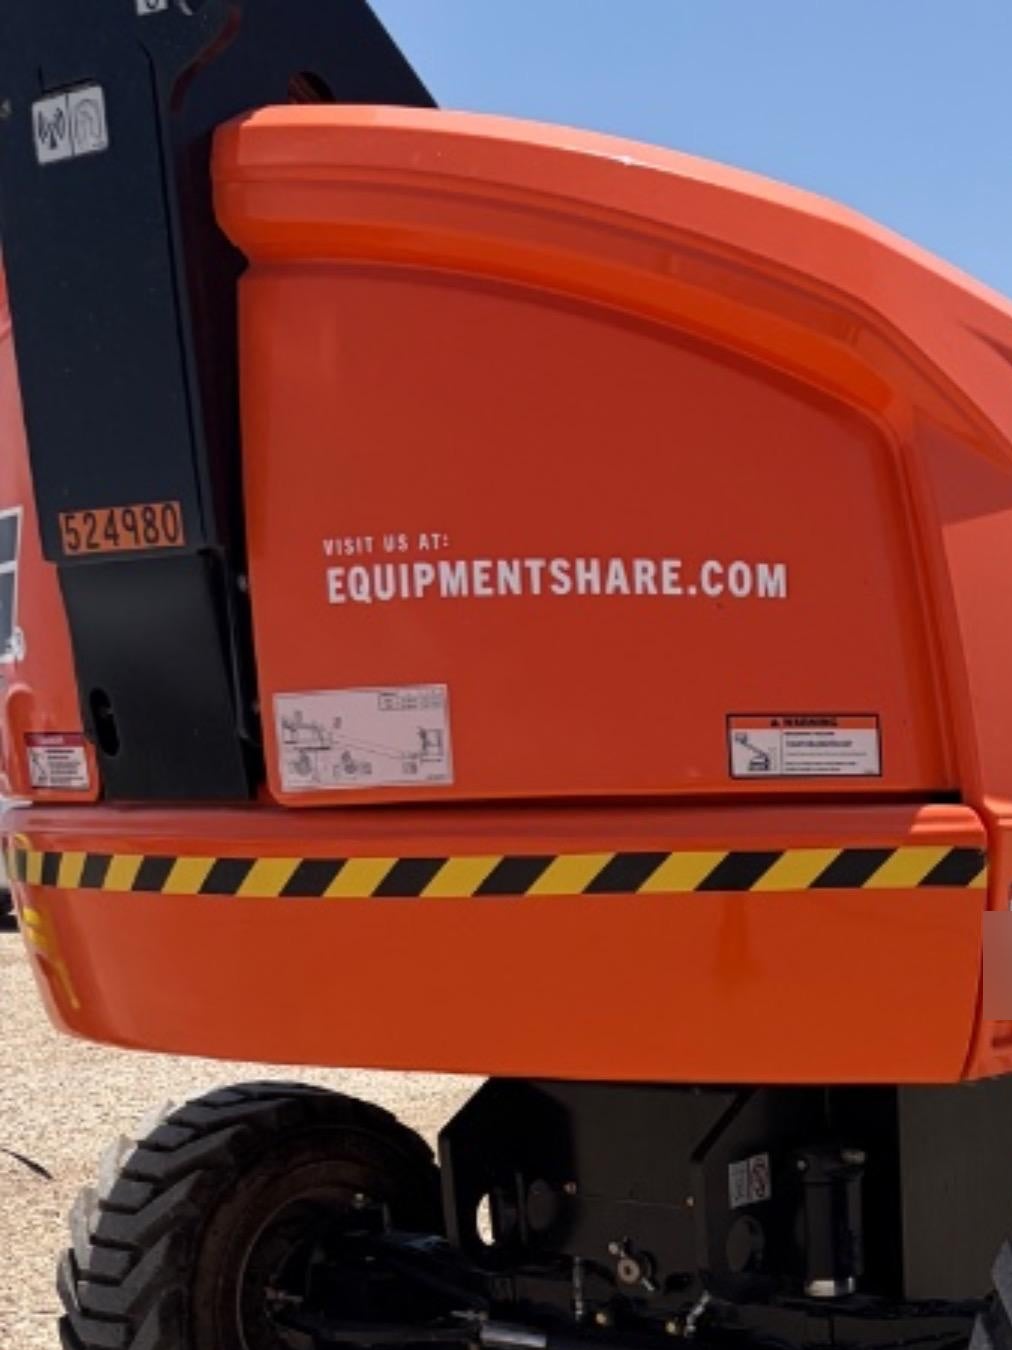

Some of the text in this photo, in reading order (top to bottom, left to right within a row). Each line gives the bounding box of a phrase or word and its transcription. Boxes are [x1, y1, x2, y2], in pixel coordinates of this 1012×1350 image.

[64, 503, 179, 551] 524980
[322, 532, 449, 556] VISIT US AT:
[326, 557, 788, 604] EQUIPMENTSHARE.COM
